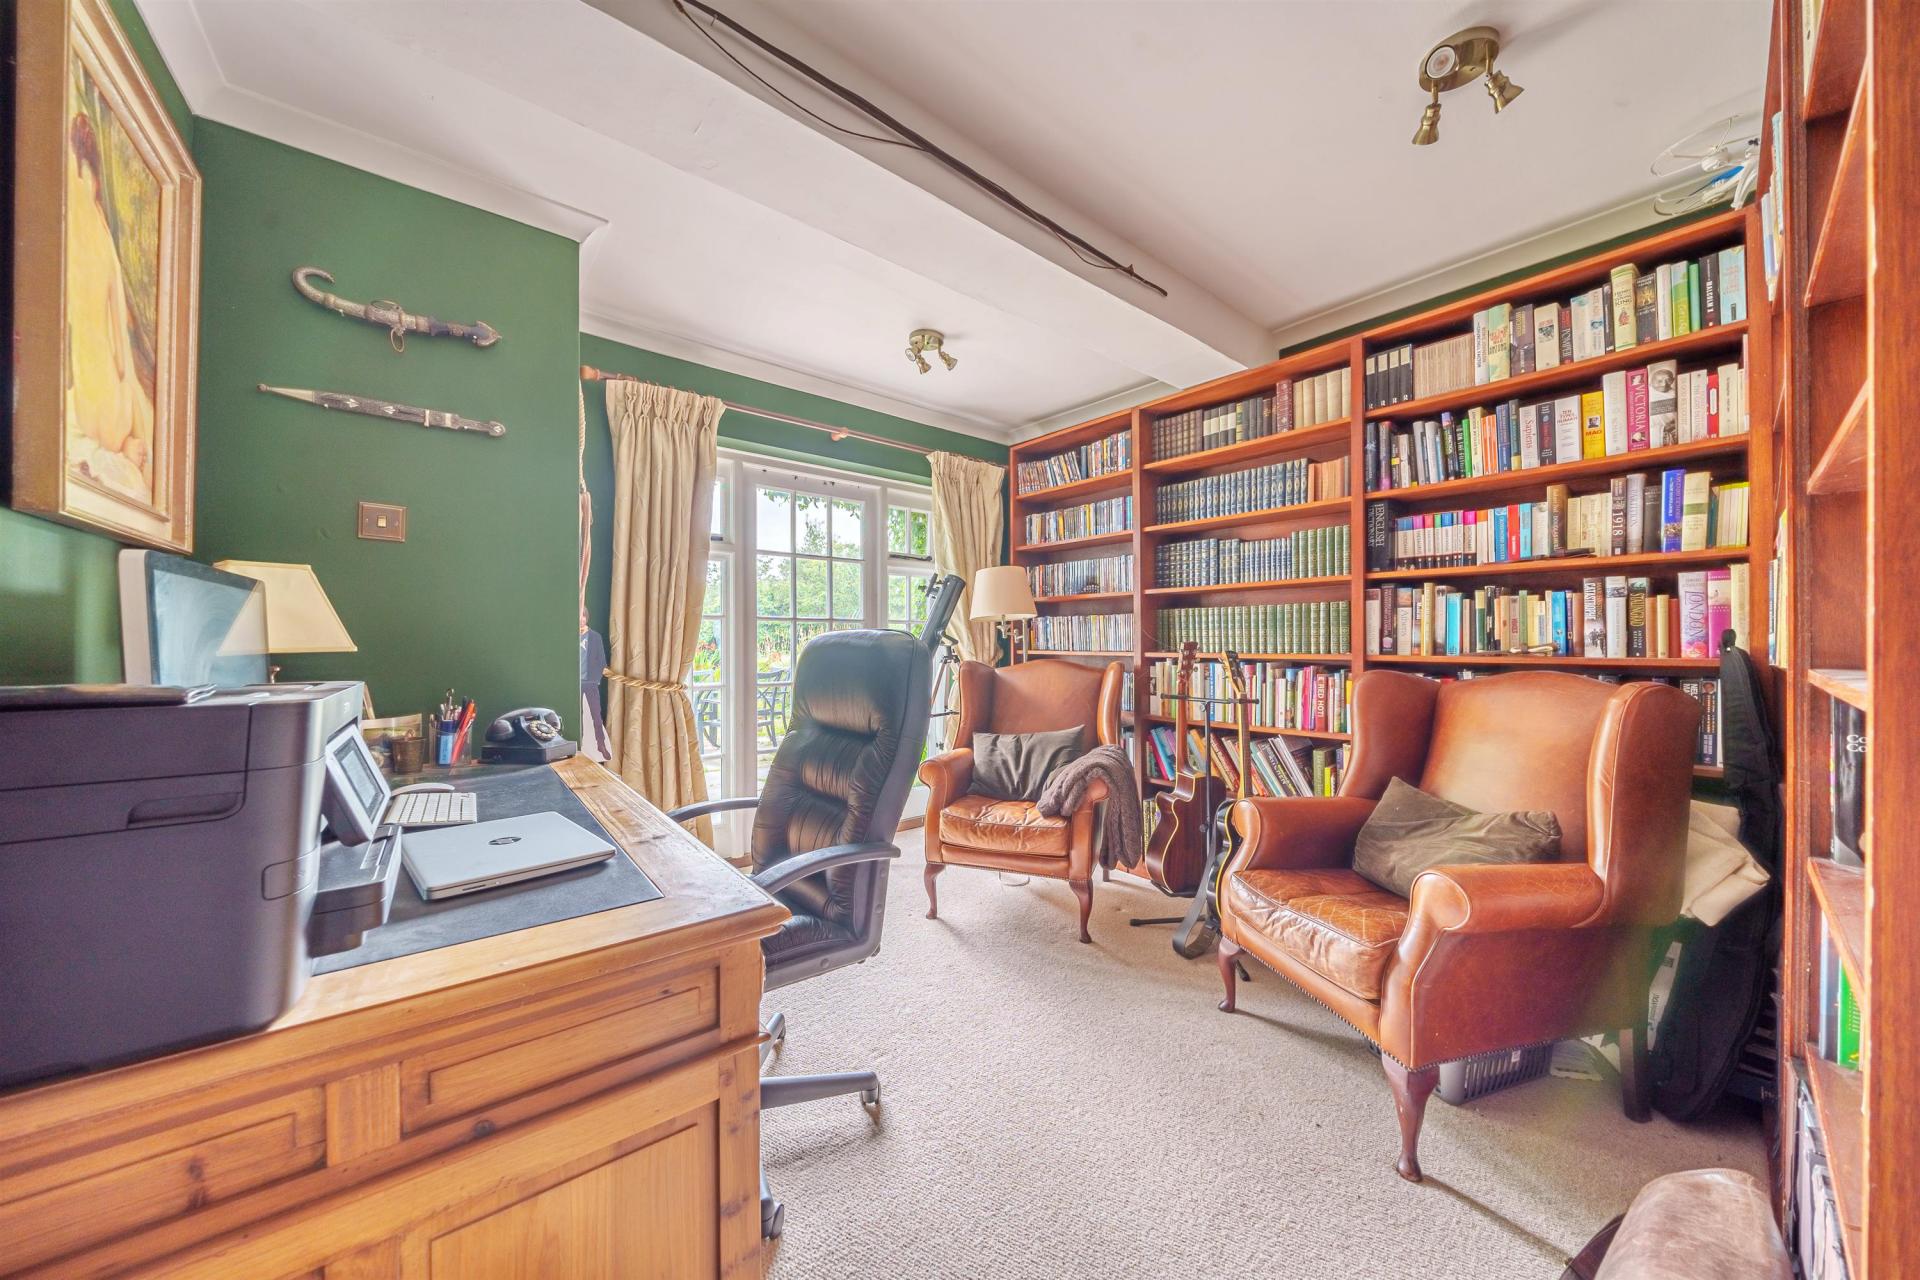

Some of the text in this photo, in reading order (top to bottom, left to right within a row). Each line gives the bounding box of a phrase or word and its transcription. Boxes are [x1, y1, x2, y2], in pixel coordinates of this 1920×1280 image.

[1705, 280, 1714, 308] MALCOLM
[1561, 328, 1571, 358] POMPEII
[1634, 384, 1645, 431] VICTORIA
[1522, 419, 1535, 449] Sapiens
[1375, 506, 1384, 547] ENGLISH
[1612, 511, 1623, 536] 1918
[1584, 583, 1595, 620] CATASTROPHE
[1630, 592, 1645, 627] STALINGRAD
[1685, 591, 1705, 637] LONDON
